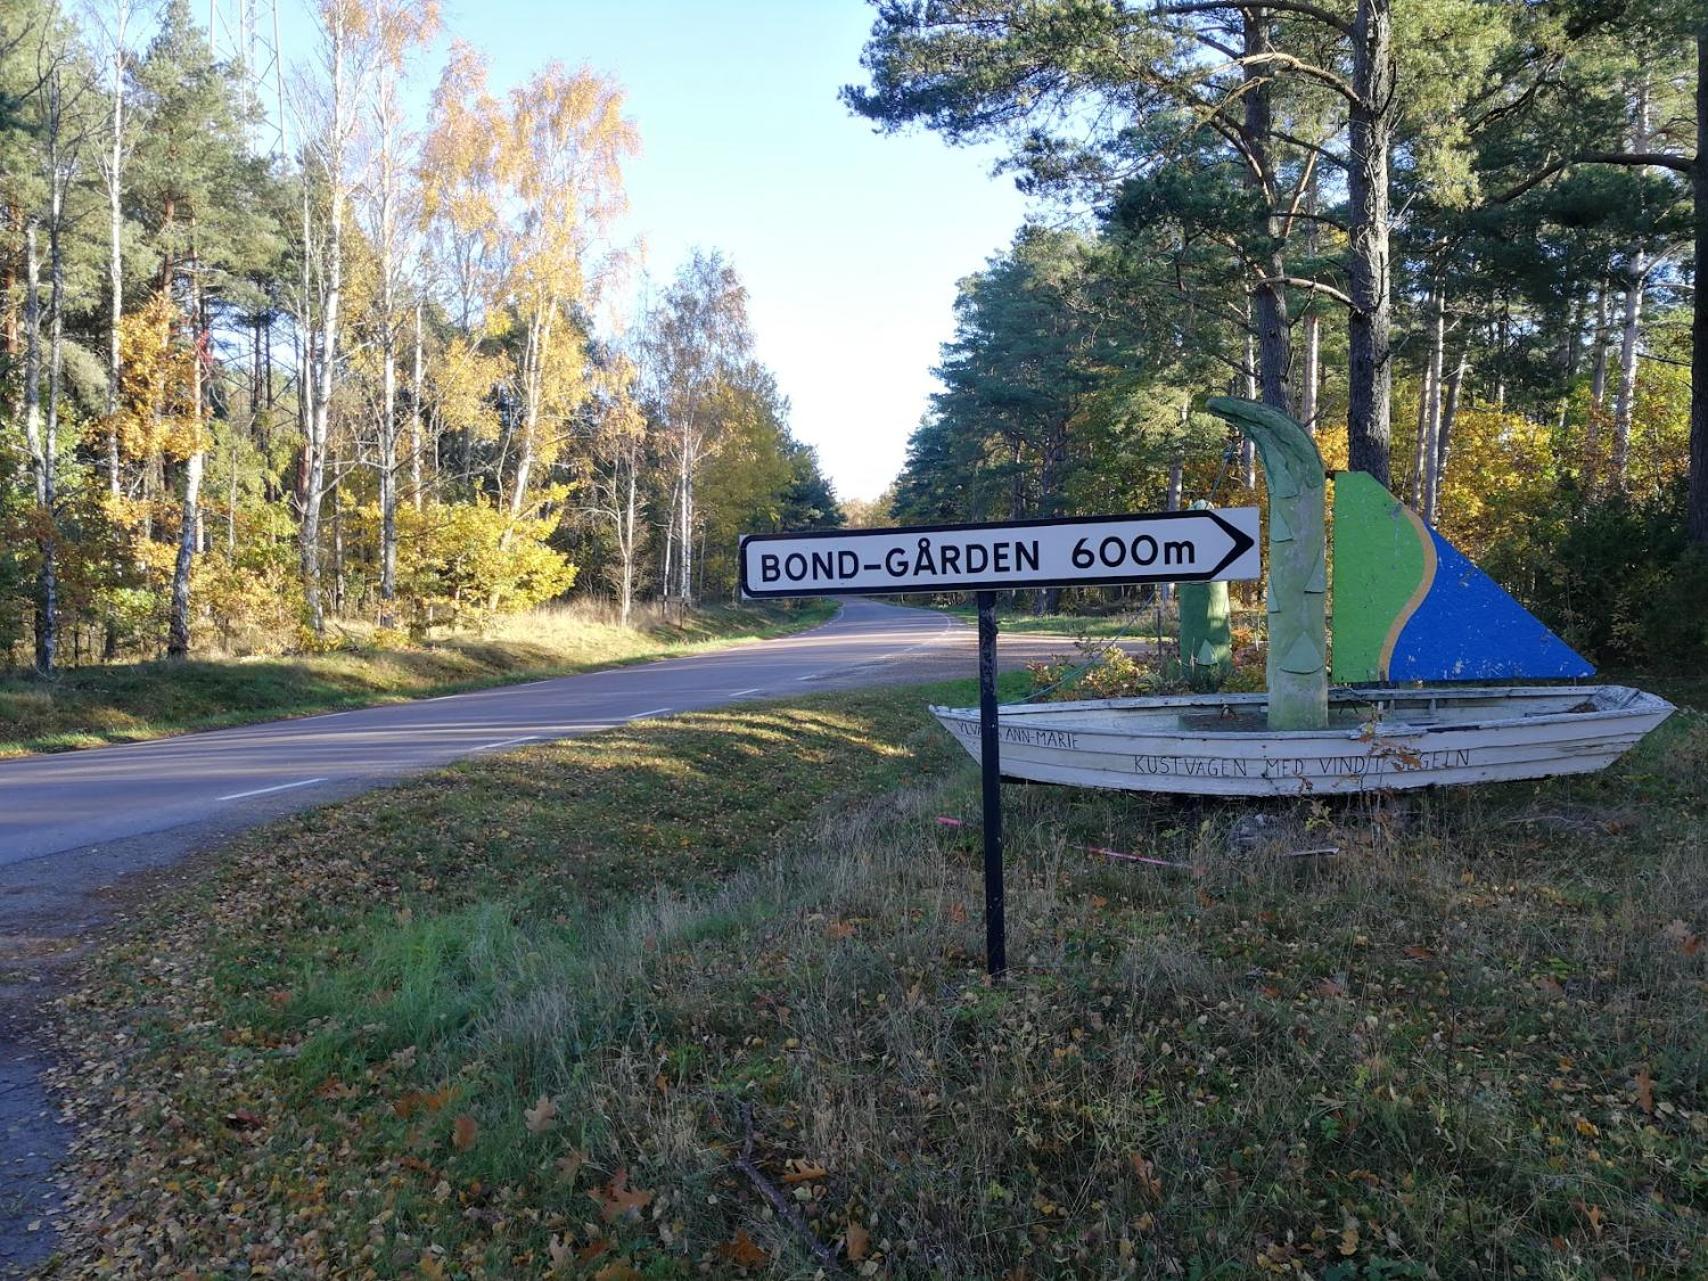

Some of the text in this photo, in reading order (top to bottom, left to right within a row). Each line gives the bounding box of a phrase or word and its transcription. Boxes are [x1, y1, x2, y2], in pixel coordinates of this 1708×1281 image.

[762, 534, 1195, 583] BOND-GÅRDEN 600m
[1005, 728, 1081, 749] ANN-MARIE
[1265, 759, 1304, 777] MED
